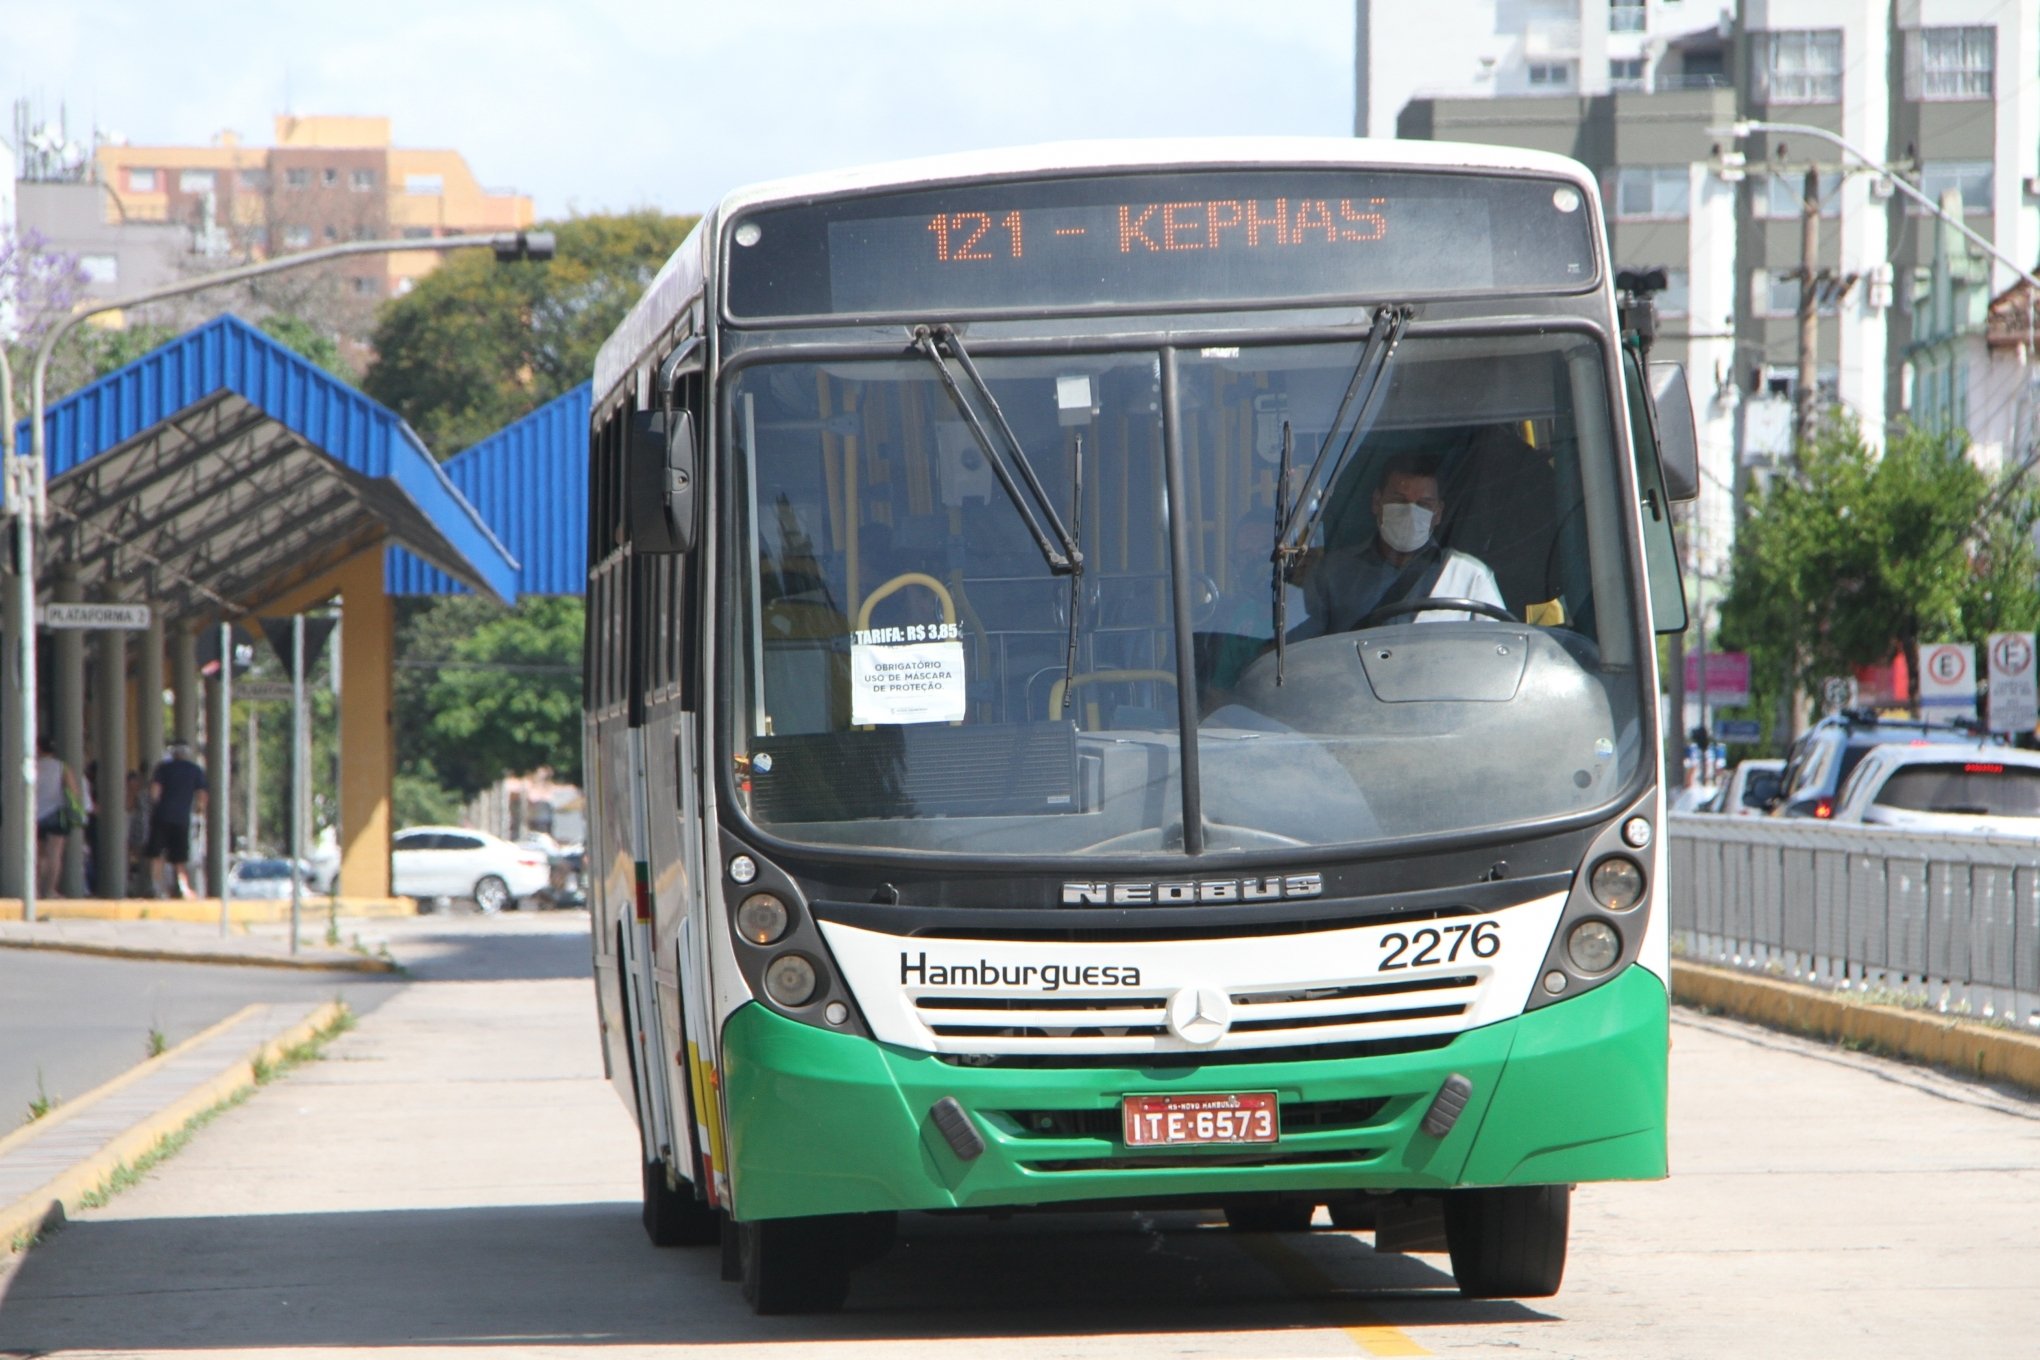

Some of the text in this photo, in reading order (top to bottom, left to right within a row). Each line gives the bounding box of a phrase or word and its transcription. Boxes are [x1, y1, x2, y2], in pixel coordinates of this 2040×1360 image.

[927, 197, 1387, 262] 121 - KEPHAS
[49, 606, 134, 622] PLATAFORMA
[855, 623, 959, 645] TARIFA: R$ 3,85
[874, 660, 942, 672] OBRIGATÓRIO
[1941, 654, 1952, 677] E
[864, 671, 952, 683] USO DE MÁSCARA
[873, 684, 886, 693] DE
[1062, 872, 1322, 904] NEOBUS
[1377, 919, 1501, 973] 2276
[900, 951, 1141, 991] Hamburguesa
